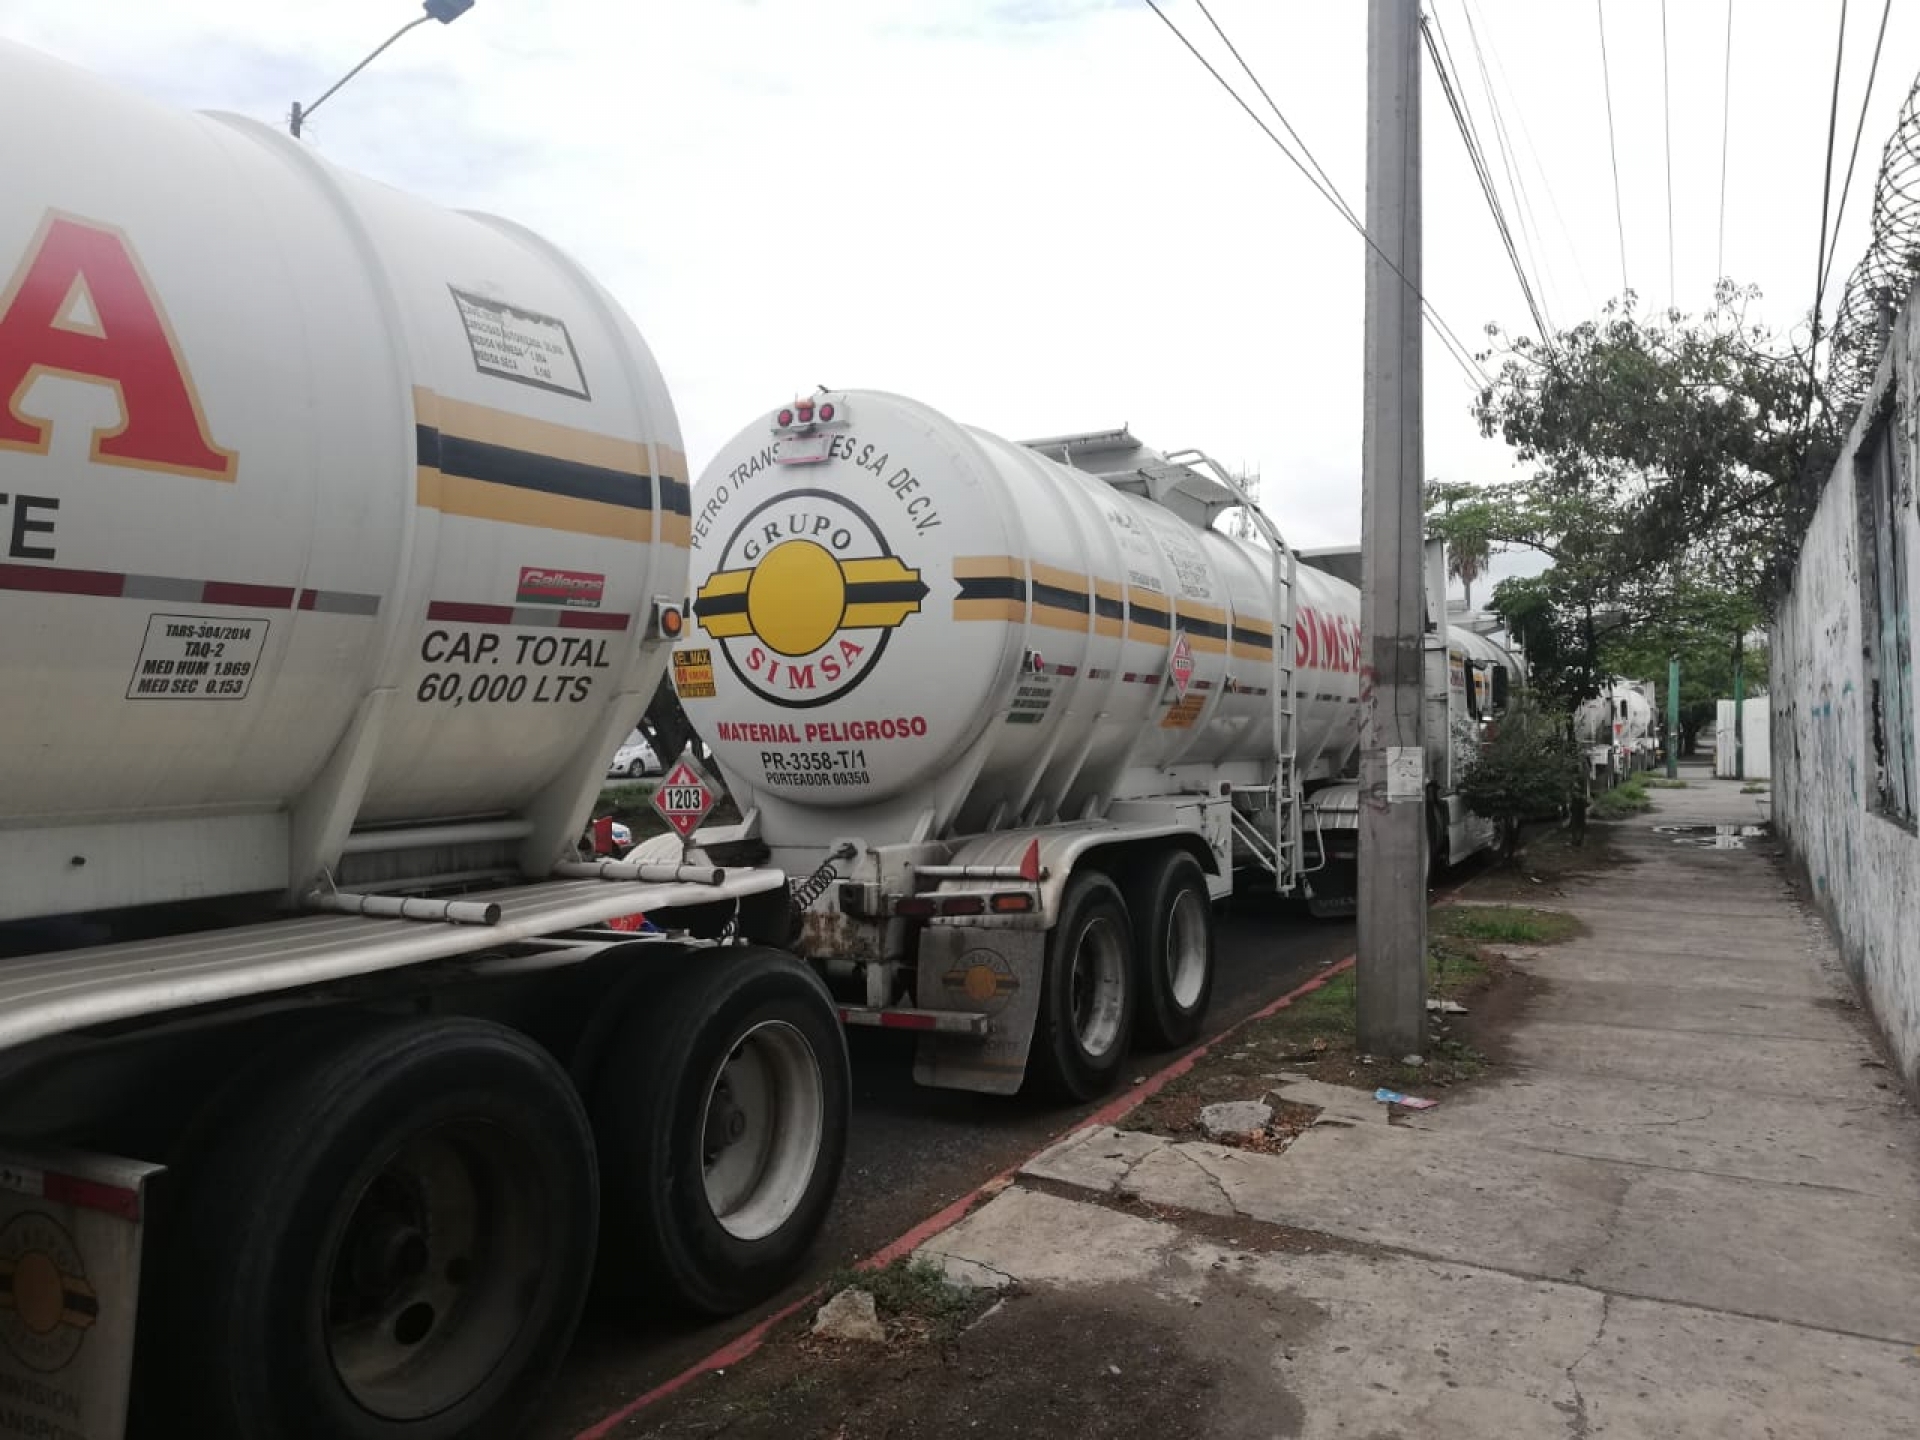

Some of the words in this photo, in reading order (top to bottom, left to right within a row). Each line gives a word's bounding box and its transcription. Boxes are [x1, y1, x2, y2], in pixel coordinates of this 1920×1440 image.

[691, 485, 729, 550] PETRO
[887, 467, 920, 500] DE
[907, 496, 942, 536] C.V.
[743, 513, 852, 560] GRUPO
[185, 641, 225, 659] TAQ-2
[421, 630, 499, 664] CAP.
[515, 635, 611, 668] TOTAL
[142, 659, 175, 676] MED
[176, 660, 210, 676] HUM
[746, 638, 864, 690] SIMSA
[137, 678, 170, 694] MED
[170, 678, 199, 694] SEC
[417, 673, 528, 708] 60,000
[532, 675, 592, 703] LTS
[717, 721, 801, 743] MATERIAL
[804, 716, 927, 743] PELIGROSO
[761, 750, 867, 770] PR-3358-T/1
[766, 771, 831, 786] PORTEADOR
[667, 789, 701, 810] 1203
